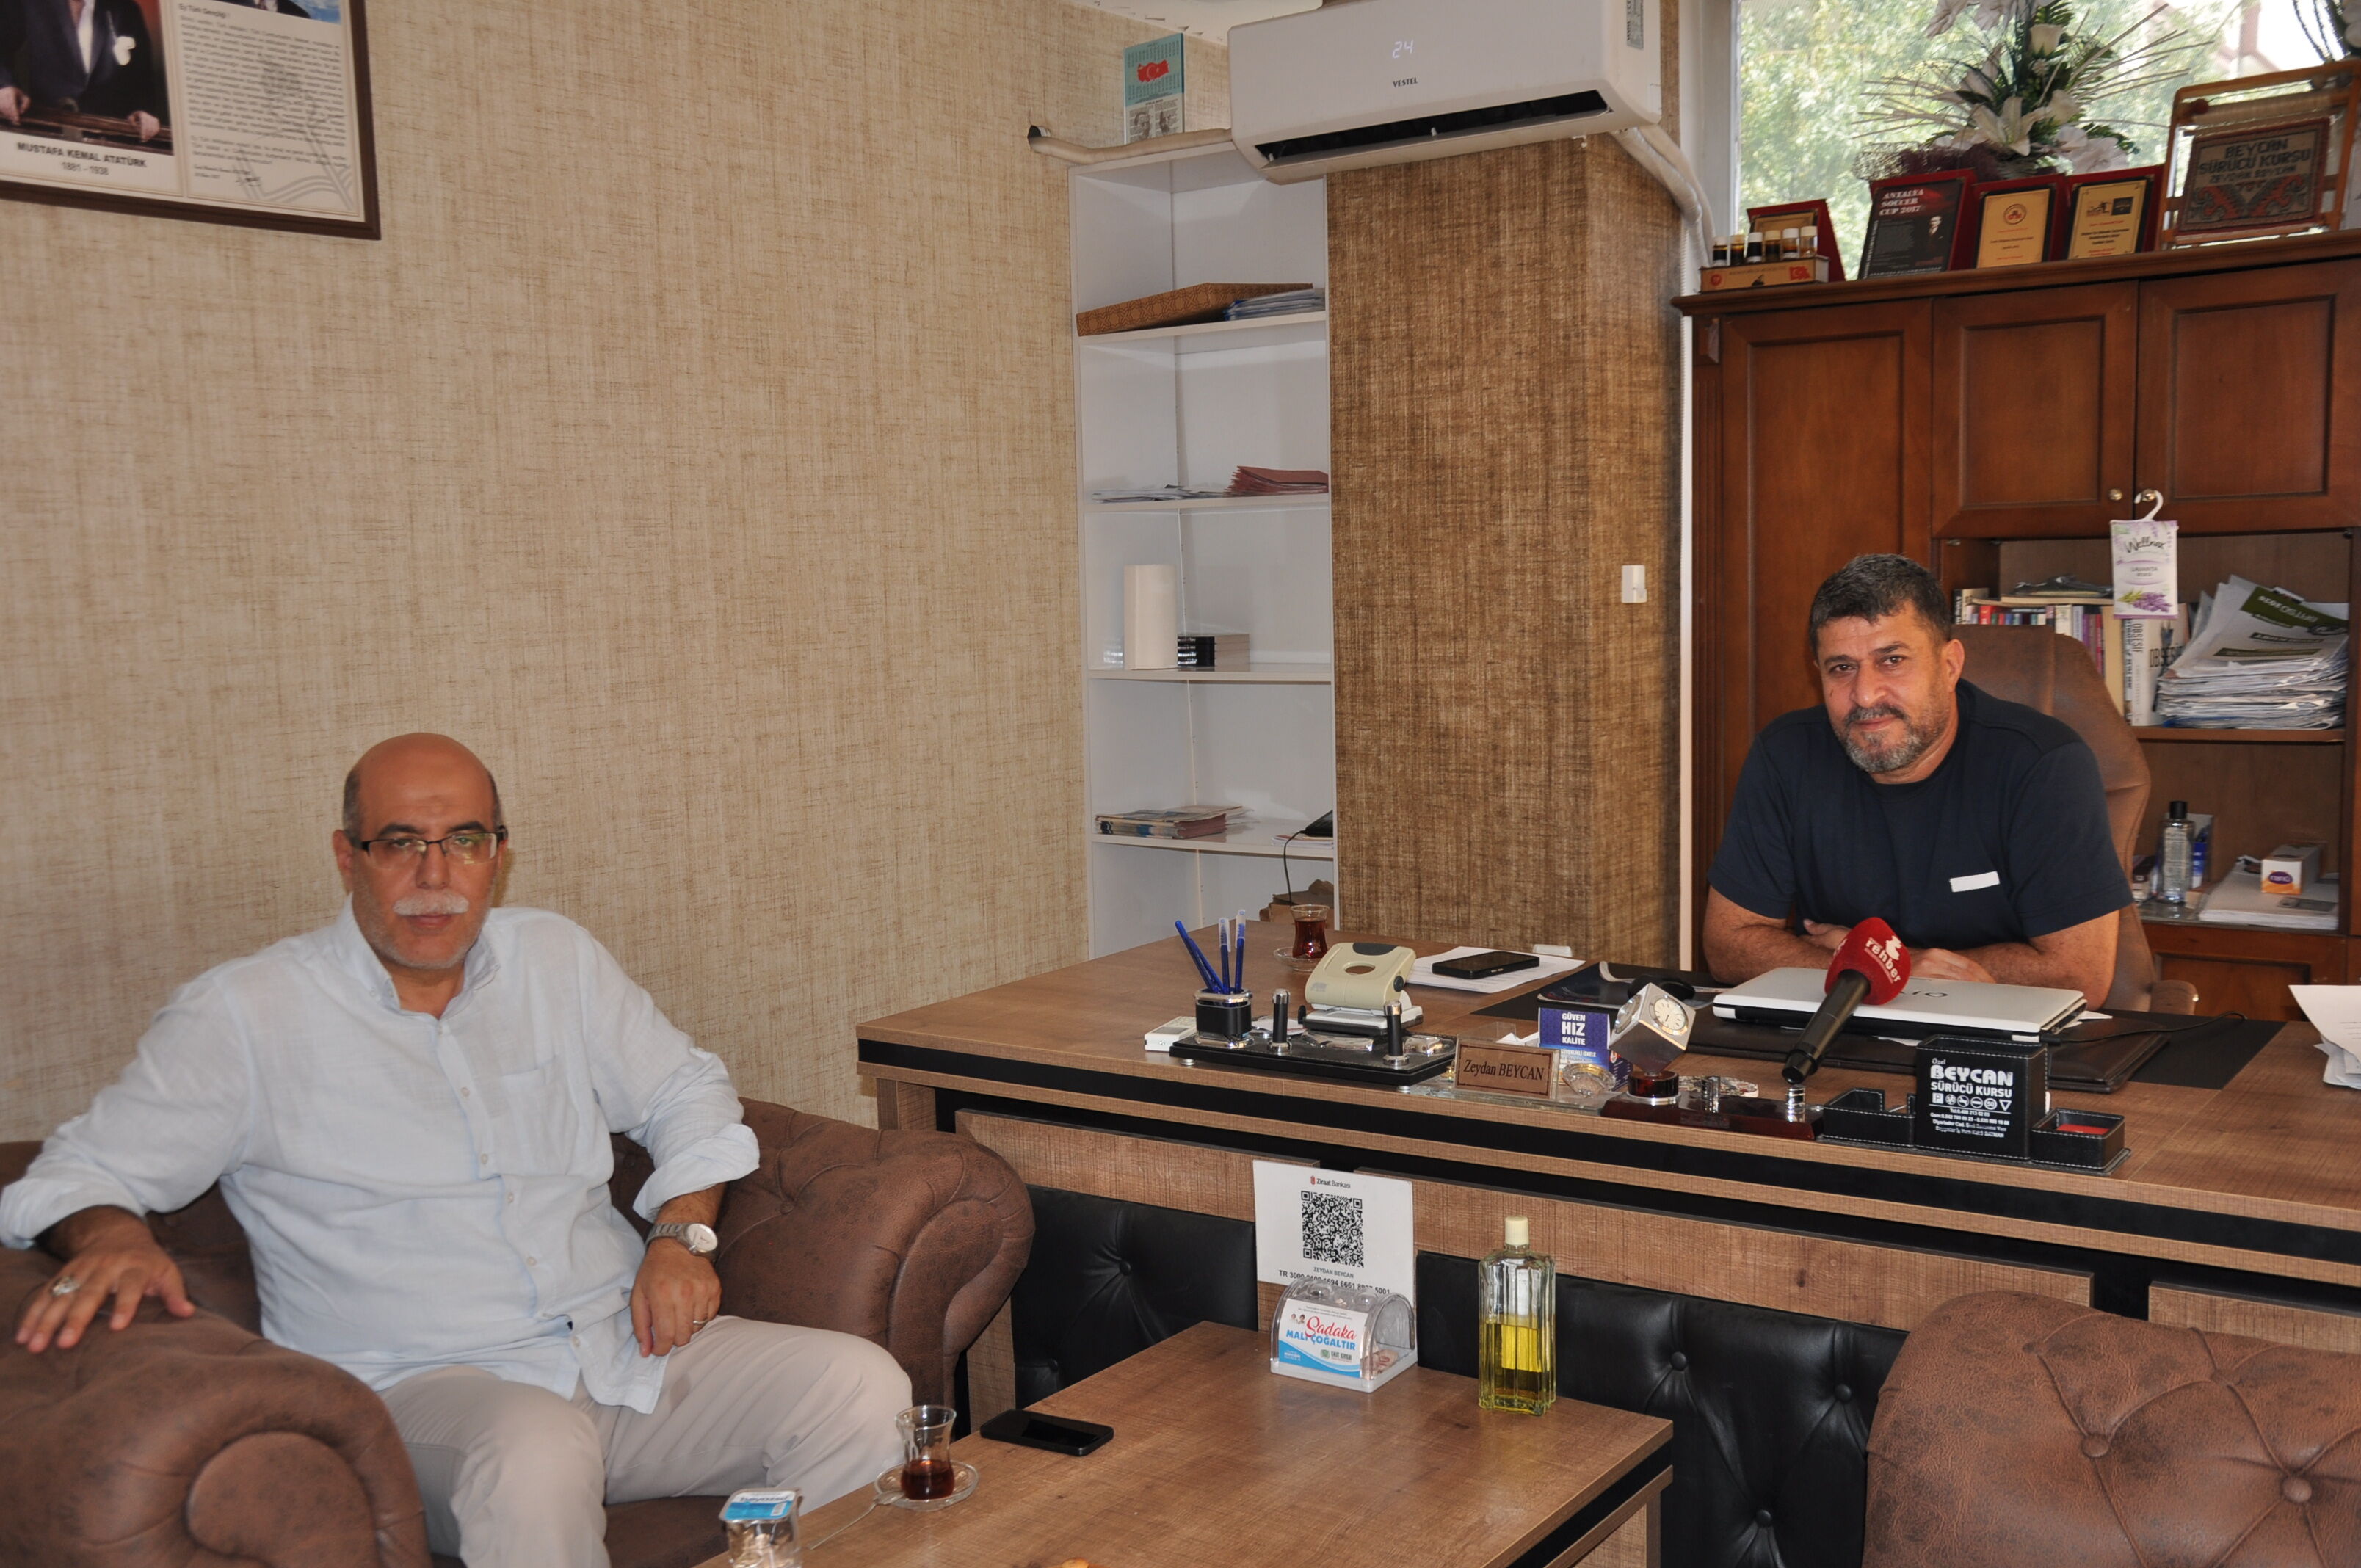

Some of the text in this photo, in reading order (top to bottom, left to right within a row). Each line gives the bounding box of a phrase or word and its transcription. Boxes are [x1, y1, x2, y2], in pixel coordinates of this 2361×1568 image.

[1392, 40, 1414, 59] 24
[1393, 77, 1418, 88] VESTEL
[16, 142, 147, 167] MUSTAFA KEMAL ATATÜRK
[2225, 139, 2288, 159] BEYCAN
[2260, 148, 2312, 167] KURSU
[1881, 197, 1919, 207] SOCCER
[1882, 189, 1924, 200] ANTALYA
[1879, 208, 1899, 216] CUP
[1865, 939, 1901, 982] rehber
[1562, 1012, 1586, 1022] GÜVEN
[1562, 1021, 1586, 1037] HIZ
[1562, 1036, 1586, 1045] KALİTE
[1463, 1059, 1545, 1081] Zeydan BEYCAN
[1930, 1064, 2013, 1086] BEYCAN
[1931, 1080, 2012, 1098] SÜRÜCÜ KURSU
[1316, 1178, 1351, 1189] Ziraat Bankası
[1313, 1266, 1354, 1279] ZEYDAN BEYCAN
[1305, 1315, 1357, 1340] Sadaka
[1310, 1335, 1356, 1350] ÇOĞALTIR
